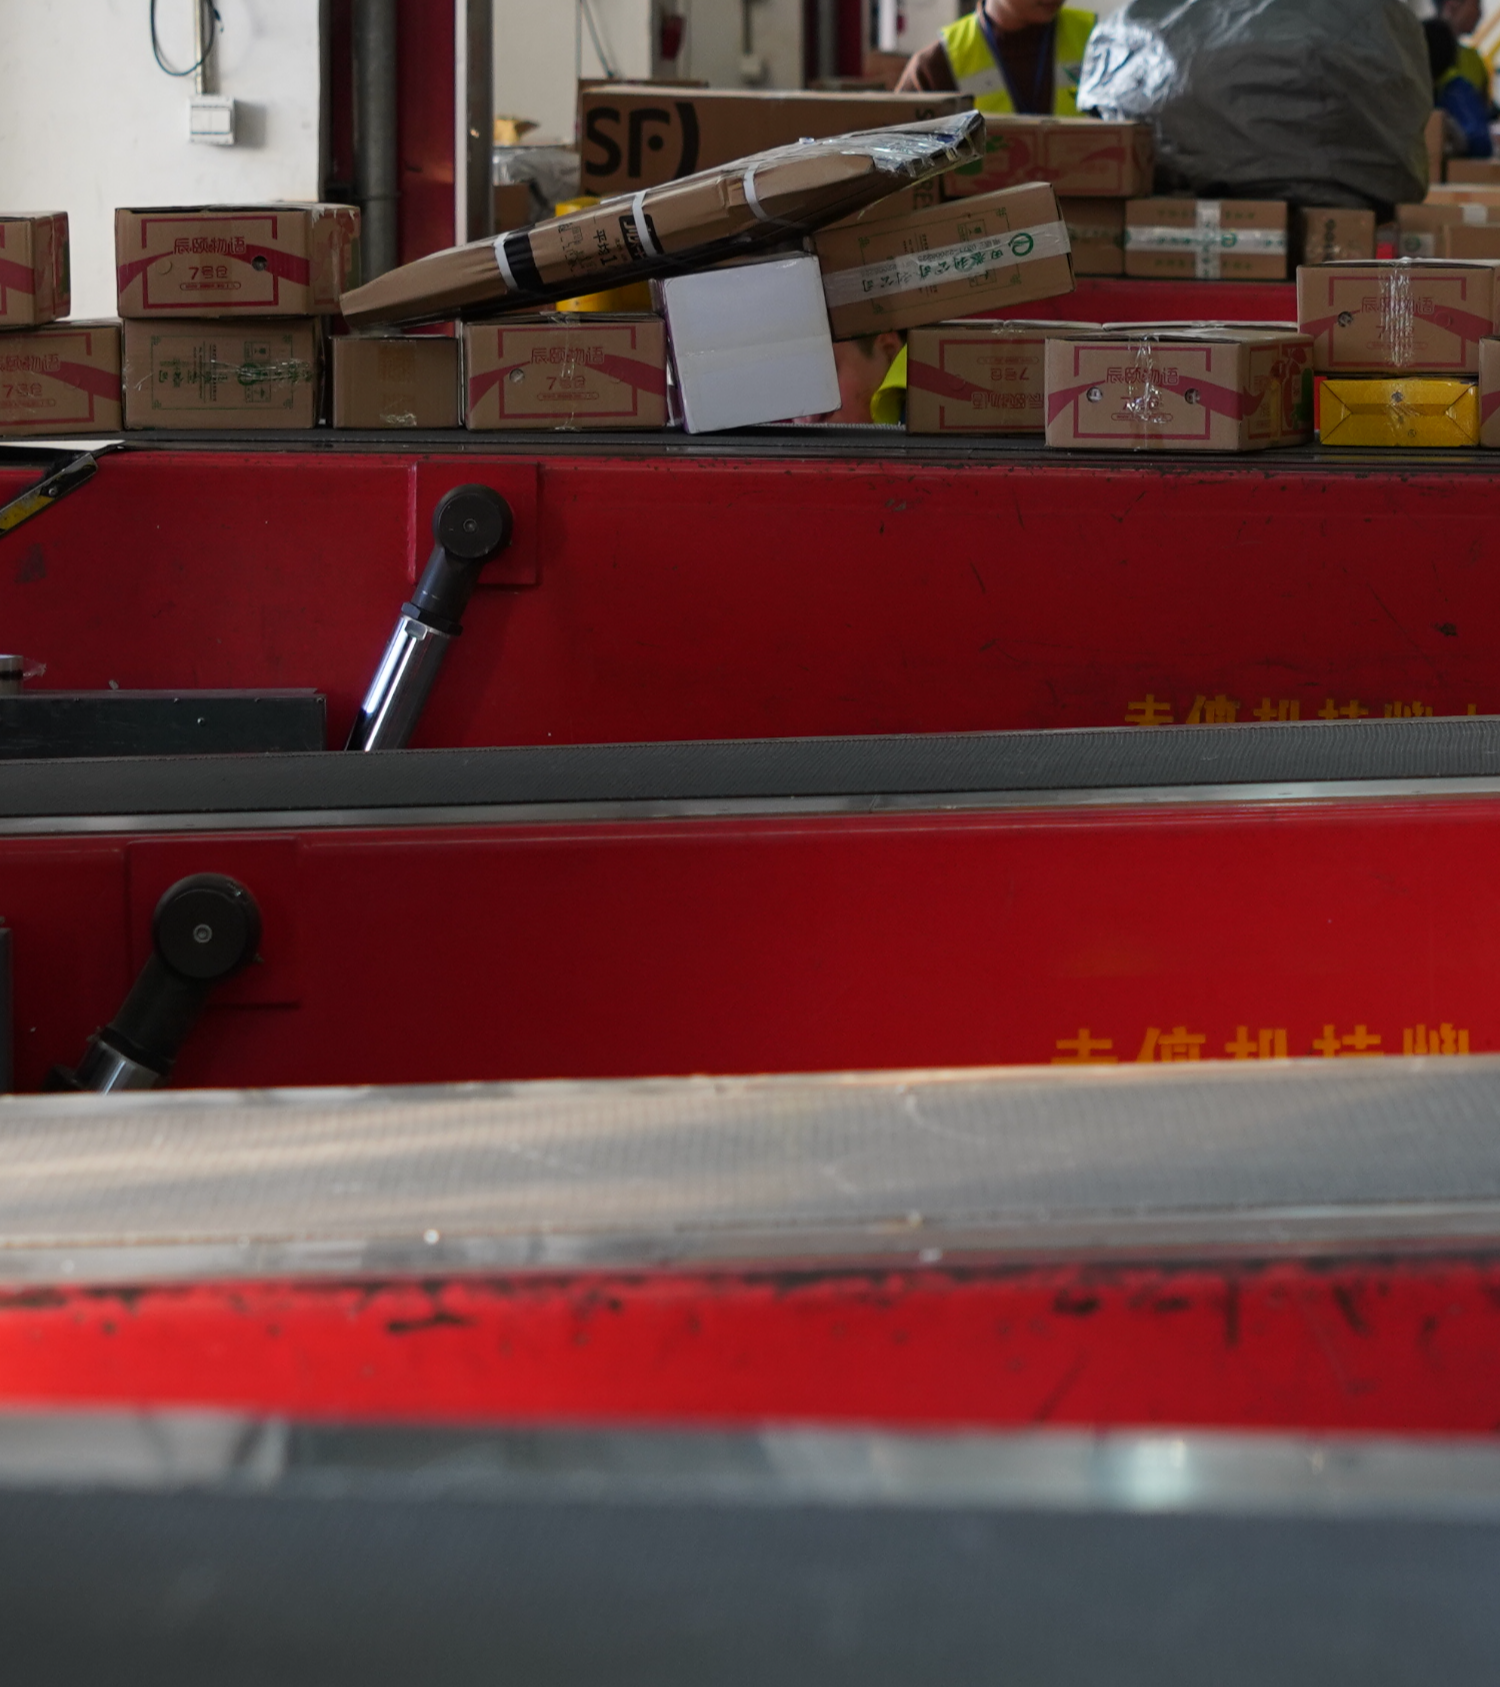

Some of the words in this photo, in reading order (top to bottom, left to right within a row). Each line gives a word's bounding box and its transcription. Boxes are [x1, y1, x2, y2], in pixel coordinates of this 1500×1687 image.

[173, 236, 248, 255] 辰颐物语
[188, 265, 229, 280] 7号仓
[531, 346, 605, 365] 辰颐物语
[1106, 366, 1180, 386] 辰颐物语
[2, 383, 43, 399] 7号仓
